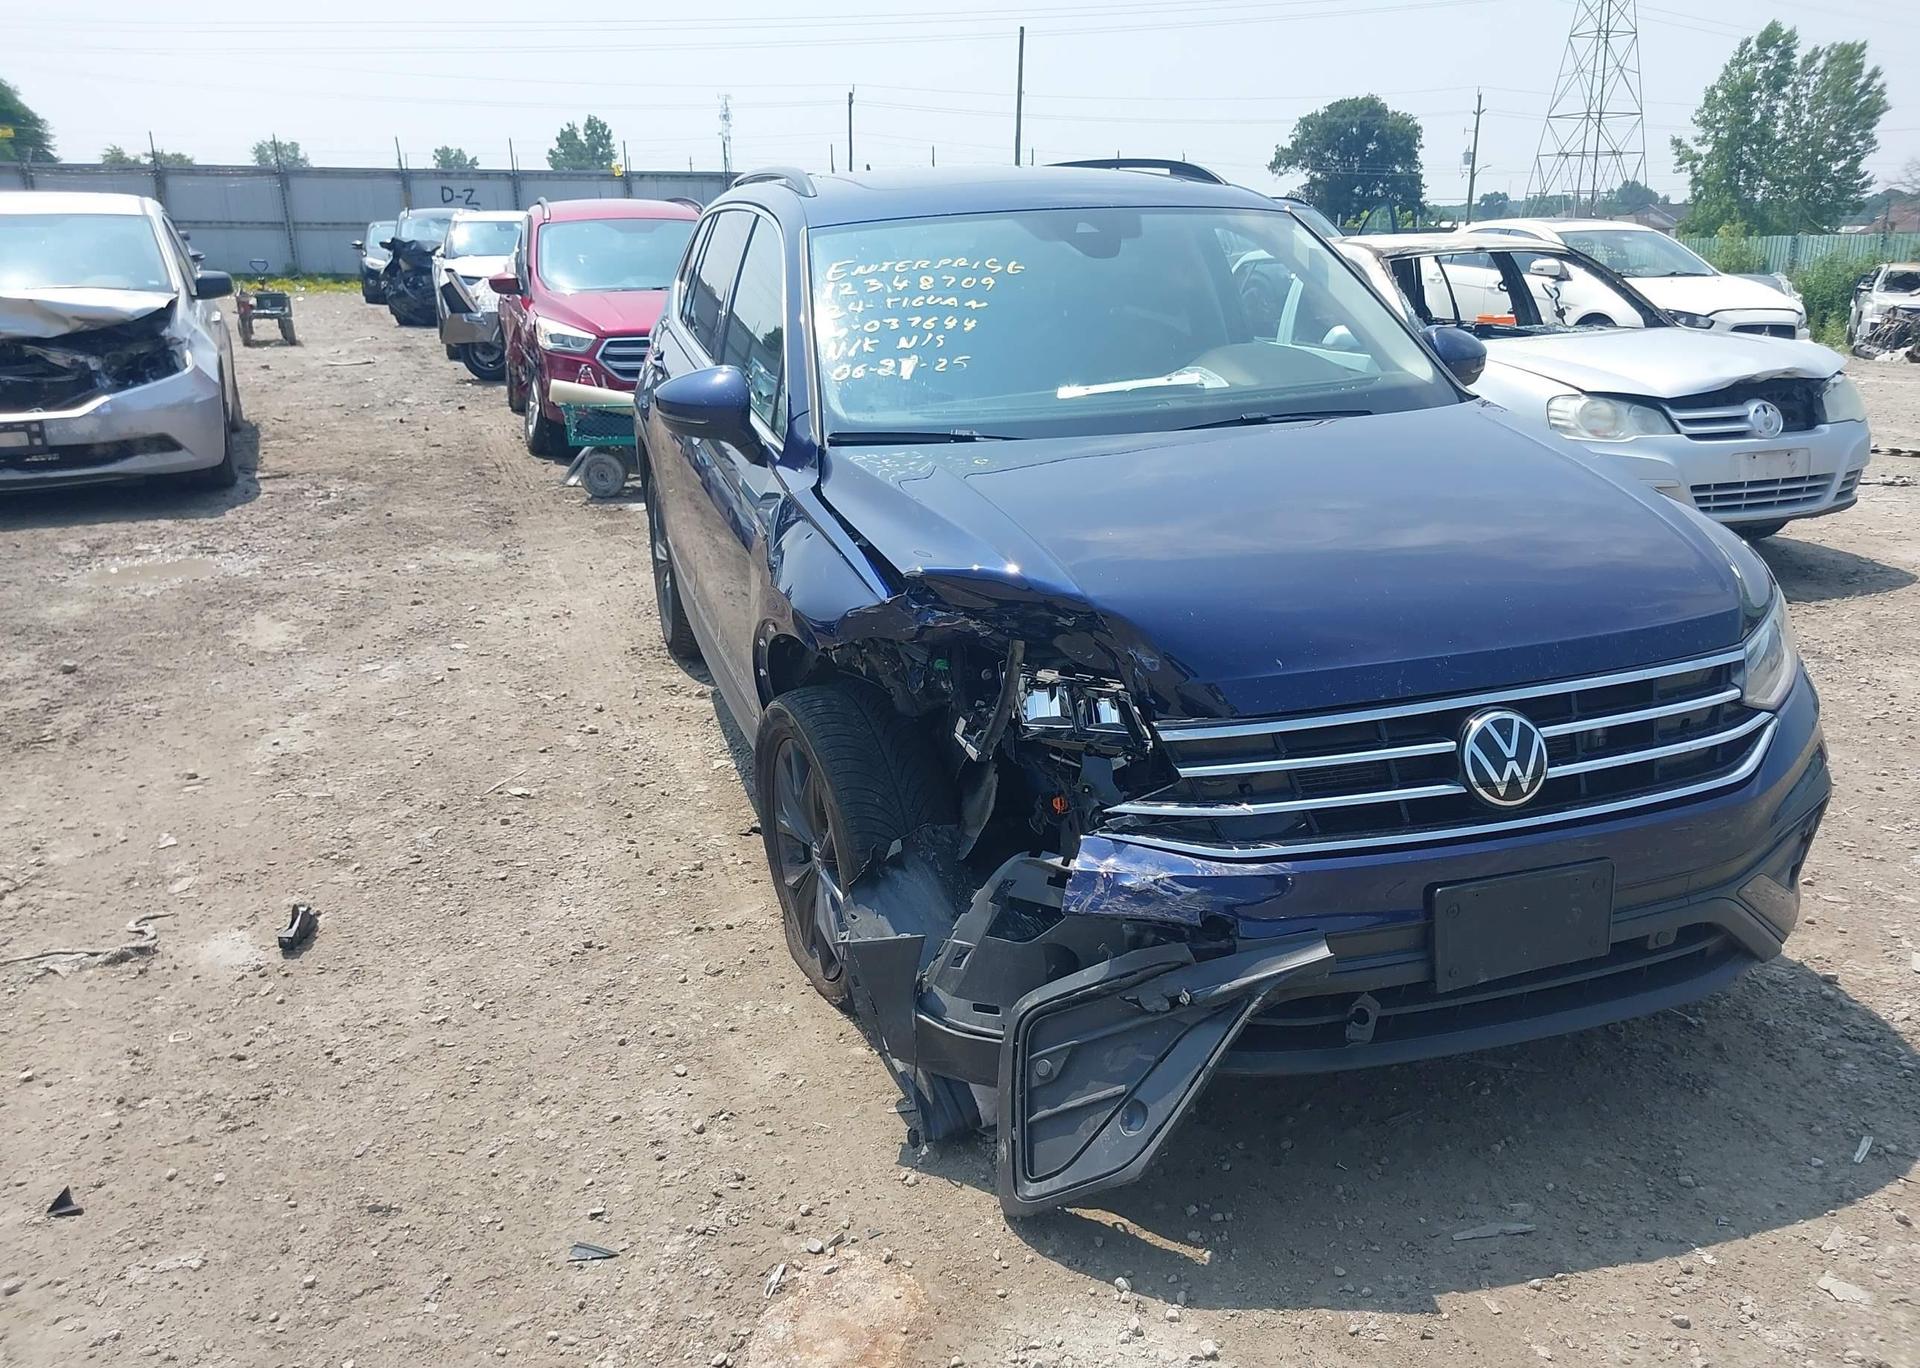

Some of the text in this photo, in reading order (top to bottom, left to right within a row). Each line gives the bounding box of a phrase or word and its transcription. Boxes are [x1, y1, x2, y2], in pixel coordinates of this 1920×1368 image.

[441, 186, 481, 206] D-Z
[826, 257, 1026, 282] ENTERPRISE
[1467, 712, 1546, 803] VW
